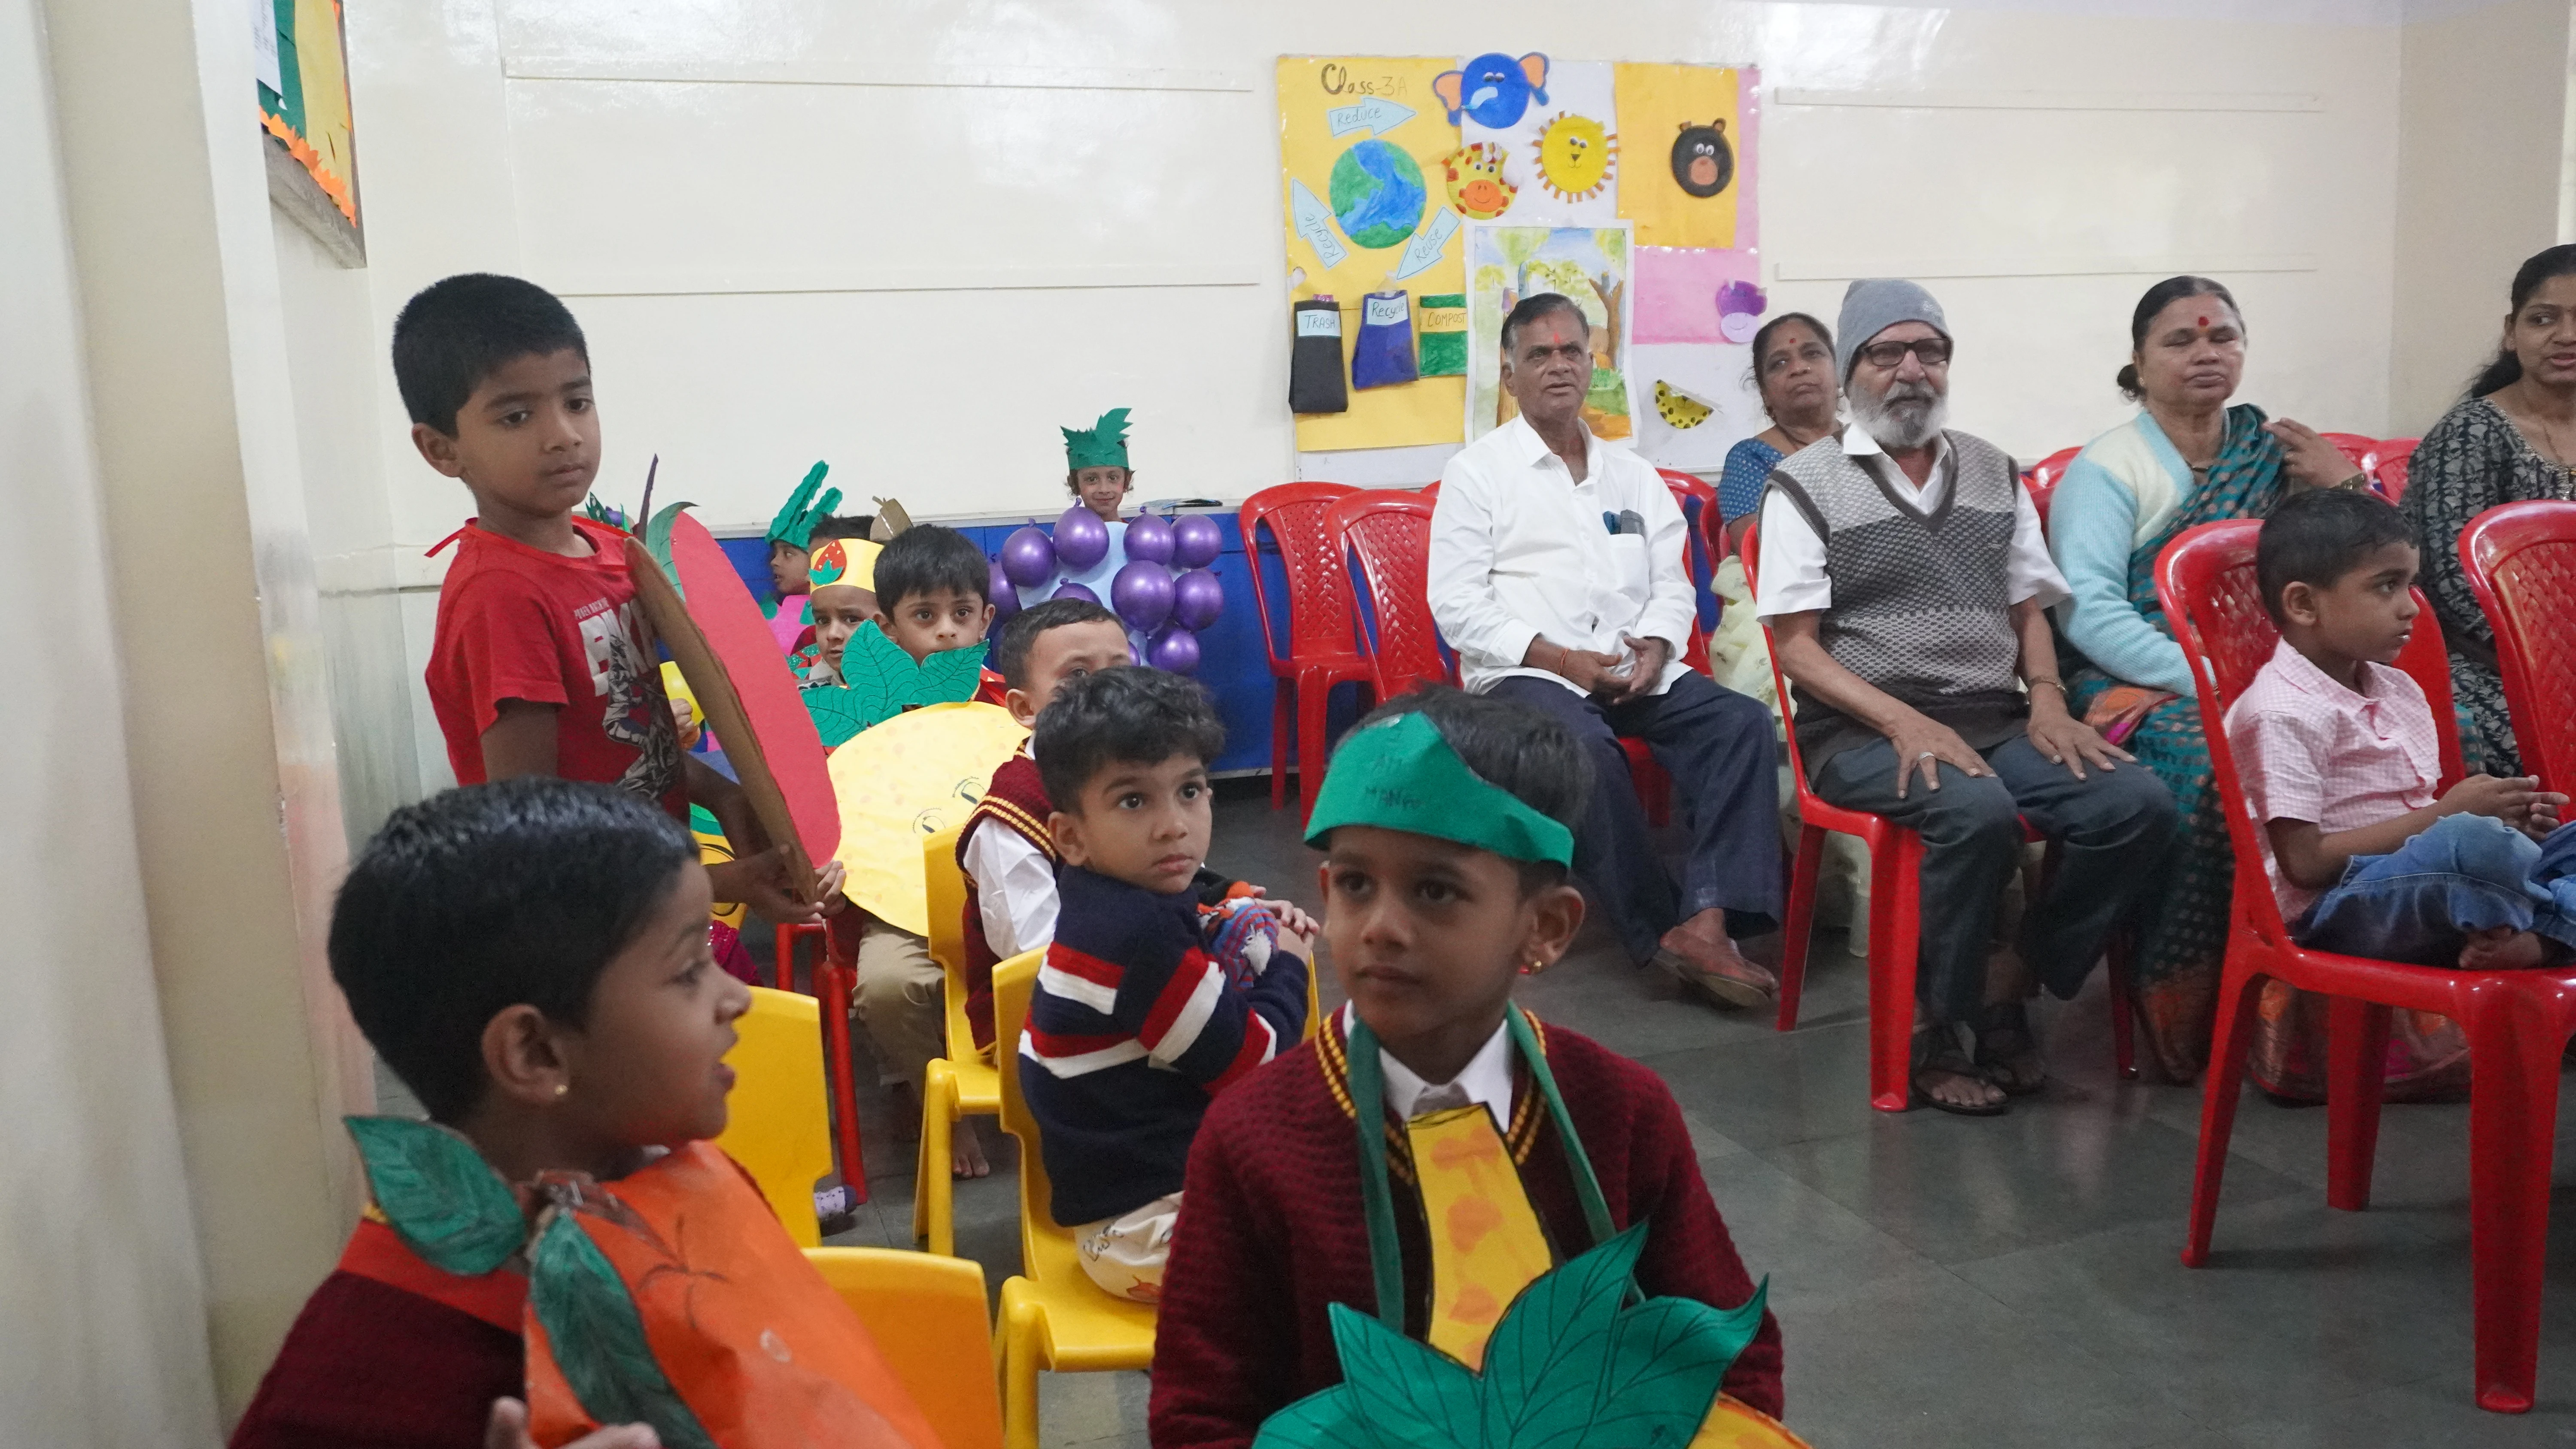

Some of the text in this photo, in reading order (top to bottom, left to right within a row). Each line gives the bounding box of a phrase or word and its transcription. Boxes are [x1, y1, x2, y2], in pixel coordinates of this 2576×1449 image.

[1337, 107, 1382, 127] Reduce
[1304, 213, 1340, 258] Recycle
[1414, 228, 1443, 264] Reuse
[1372, 300, 1405, 318] Recycle
[1304, 314, 1335, 329] TRASH
[1428, 312, 1467, 327] COMPOST
